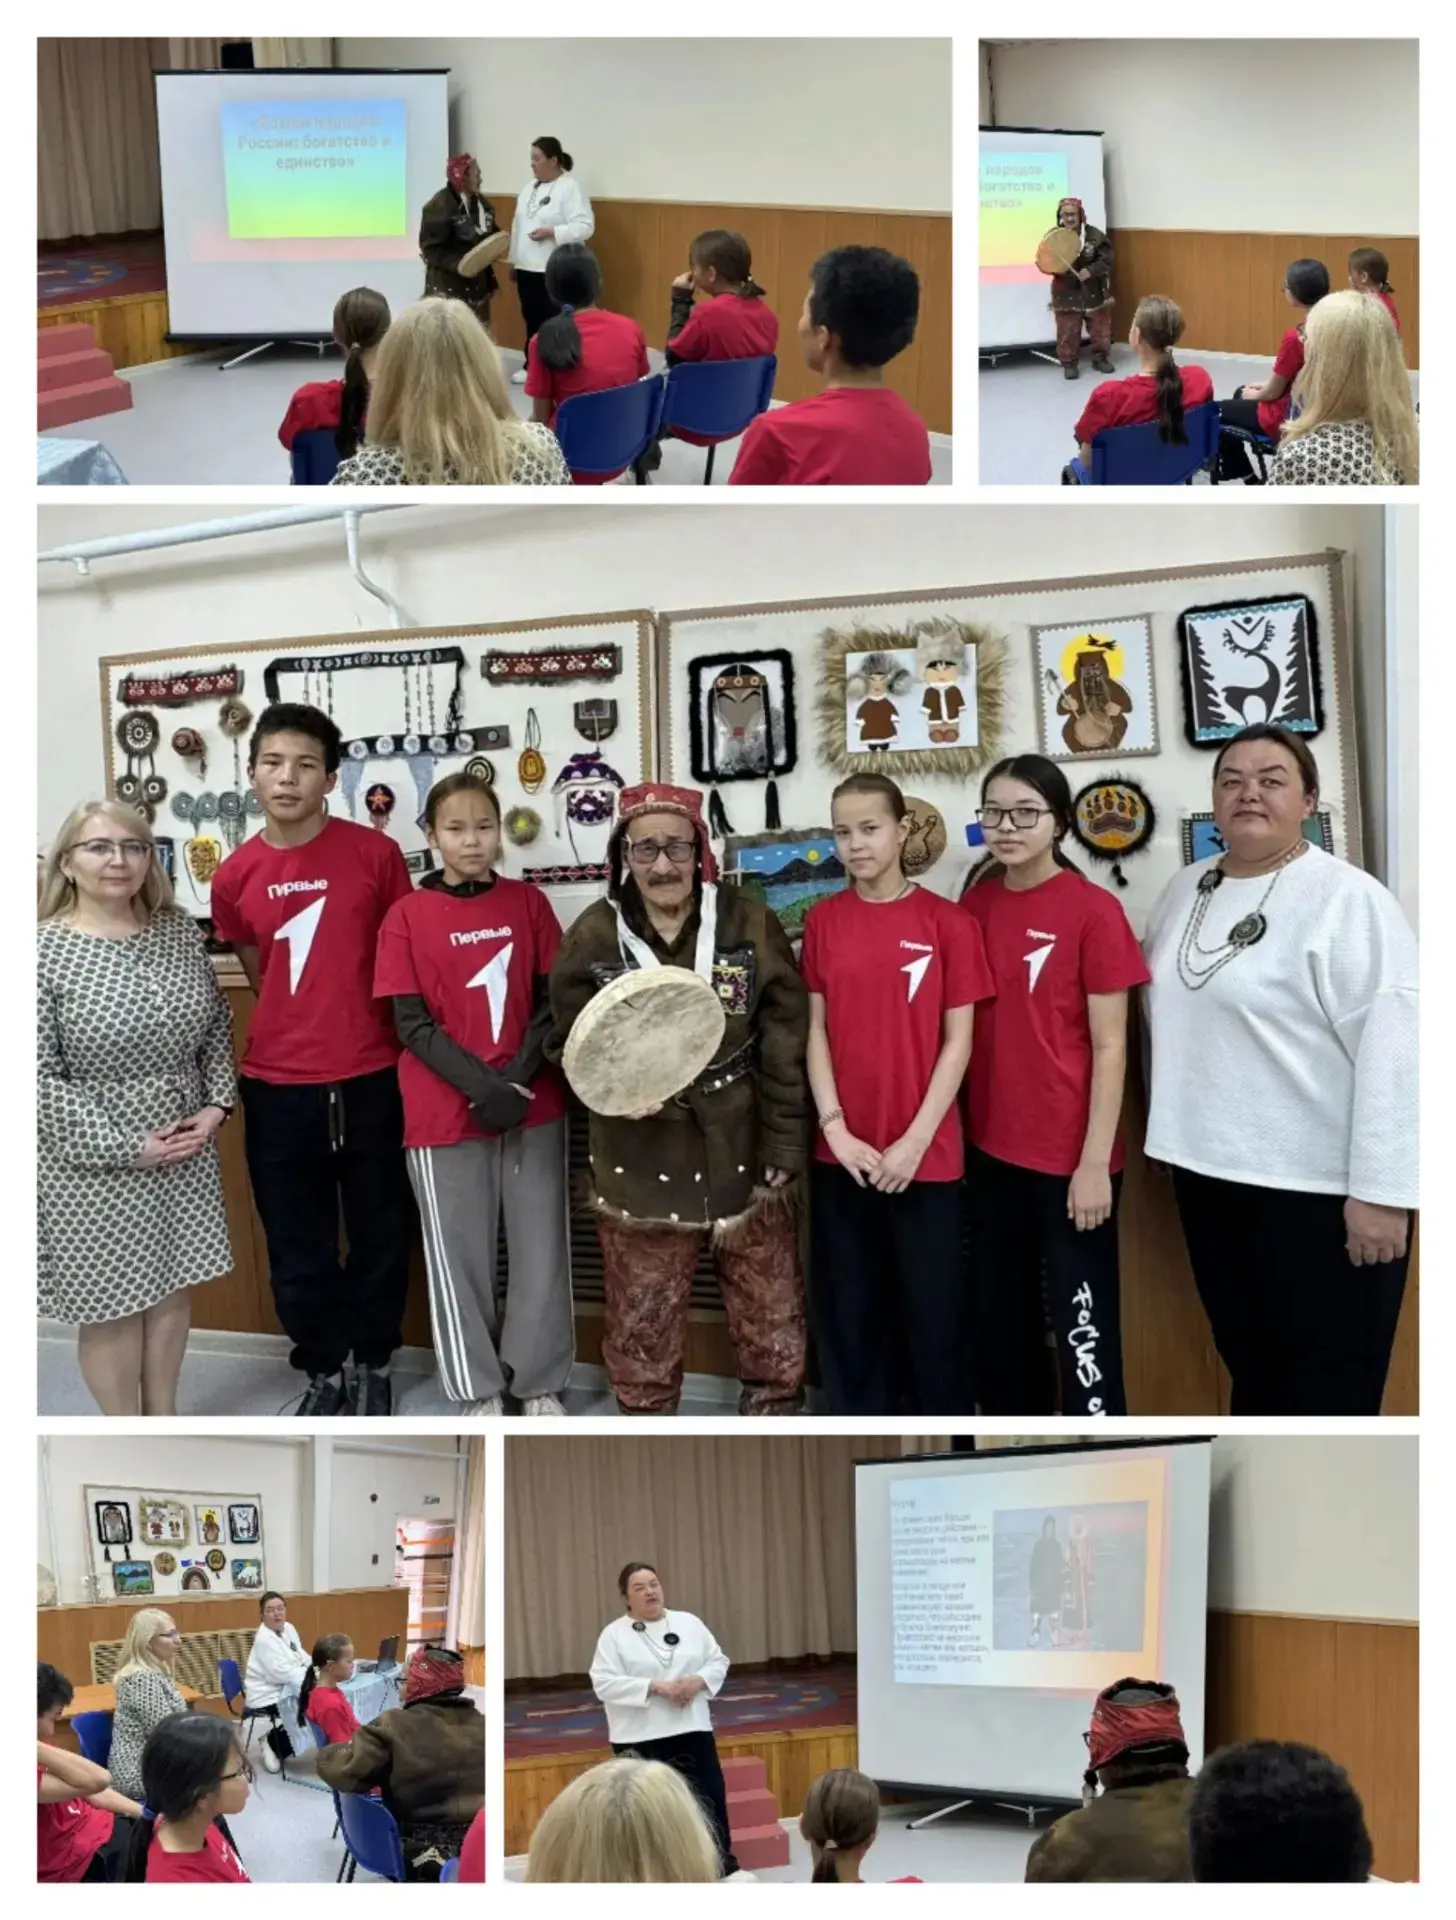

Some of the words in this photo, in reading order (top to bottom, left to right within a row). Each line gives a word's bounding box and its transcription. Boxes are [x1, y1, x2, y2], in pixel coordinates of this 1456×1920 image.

[303, 132, 378, 149] богатство
[267, 878, 329, 900] Првые
[449, 925, 513, 947] Первые
